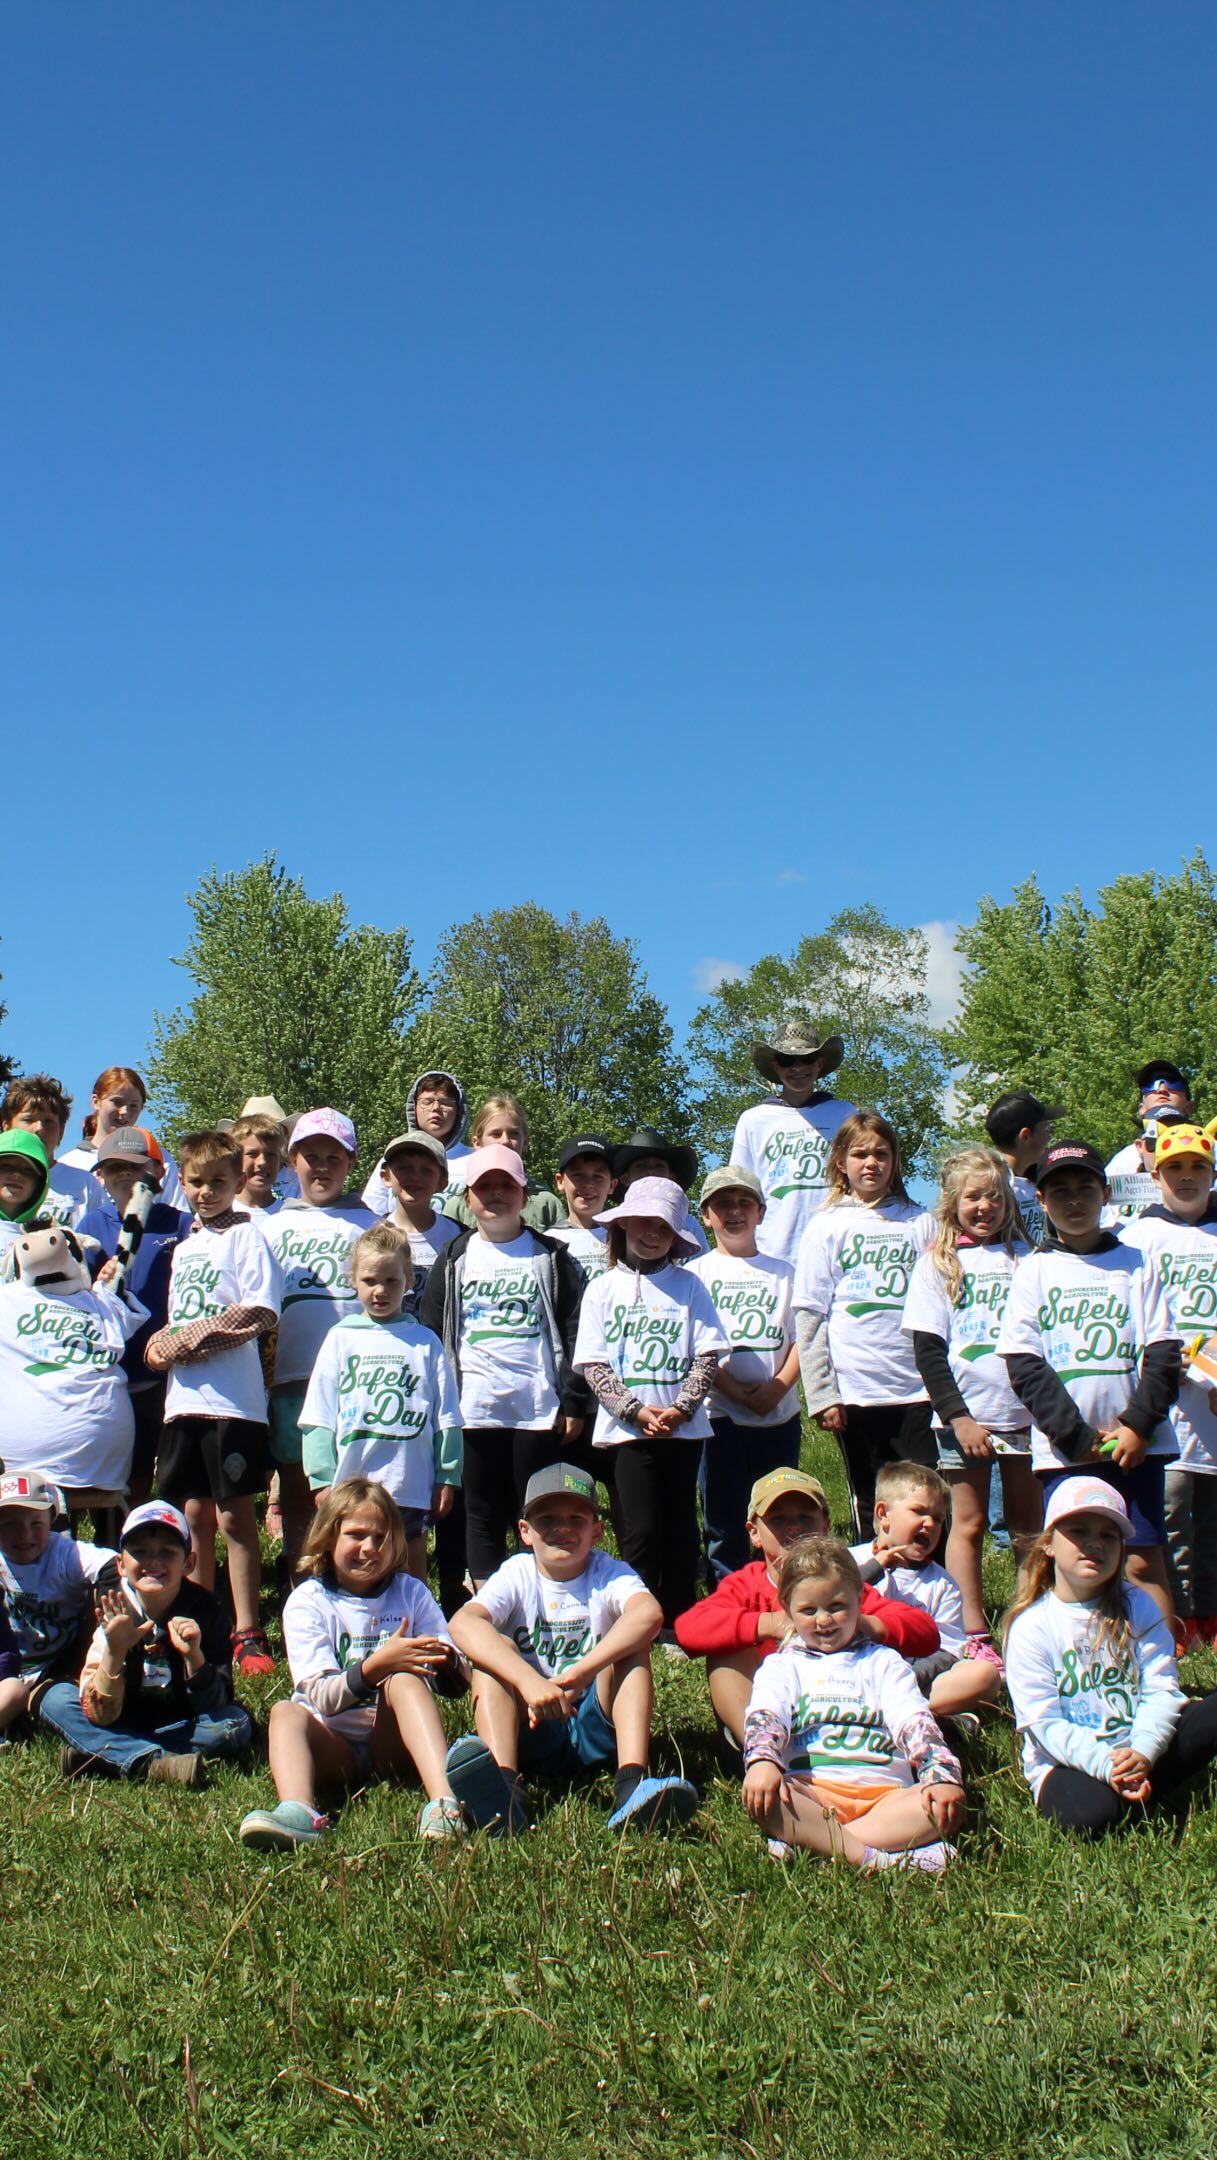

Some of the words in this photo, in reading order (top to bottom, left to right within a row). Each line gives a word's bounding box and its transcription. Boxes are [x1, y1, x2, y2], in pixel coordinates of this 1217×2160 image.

[765, 1131, 832, 1166] Safety
[1124, 1175, 1152, 1185] Allianc
[272, 1229, 352, 1264] Safety
[839, 1233, 917, 1273] Safety
[1158, 1253, 1217, 1292] Safet
[711, 1280, 777, 1315] Safety
[1038, 1287, 1131, 1330] Safety
[16, 1303, 102, 1341] Safety
[604, 1305, 683, 1344] Safety
[730, 1309, 784, 1351] Day
[55, 1334, 118, 1371] Day
[338, 1354, 422, 1398] Safety
[363, 1388, 428, 1440] Day
